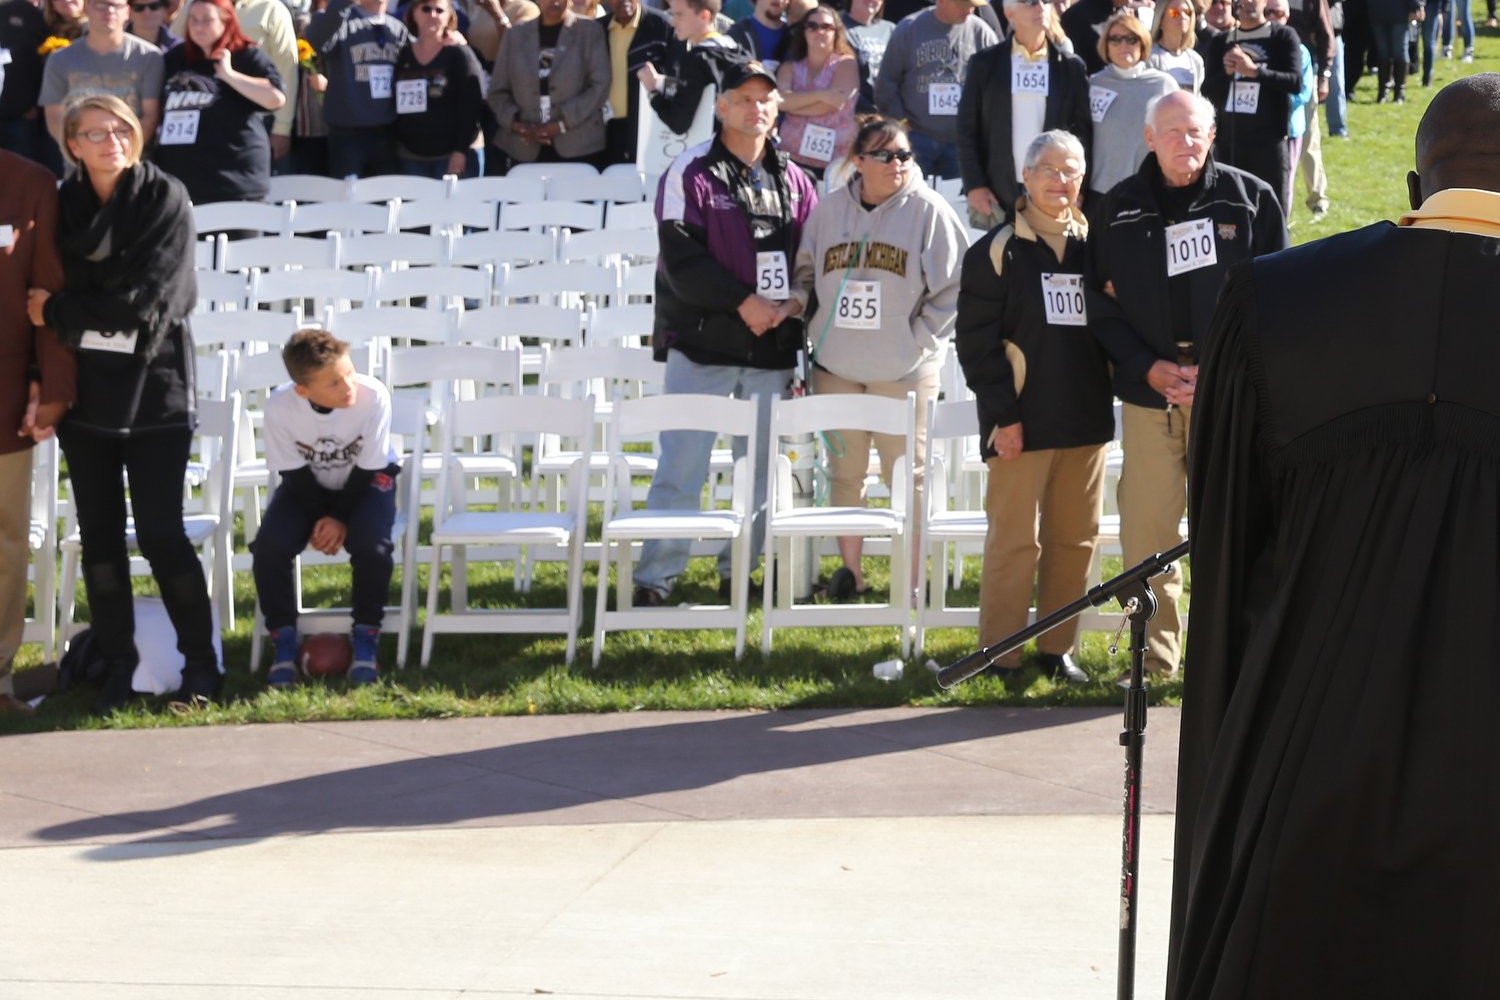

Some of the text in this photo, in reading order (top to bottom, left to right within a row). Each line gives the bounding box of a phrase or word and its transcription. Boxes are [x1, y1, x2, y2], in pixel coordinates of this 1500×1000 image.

[373, 77, 391, 91] 72
[1016, 73, 1045, 88] 1654
[932, 94, 958, 108] 1645
[166, 122, 195, 136] 914
[804, 135, 832, 153] 1652
[1170, 234, 1211, 264] 1010
[760, 268, 785, 290] 55
[839, 296, 877, 320] 855
[1047, 291, 1085, 315] 1010
